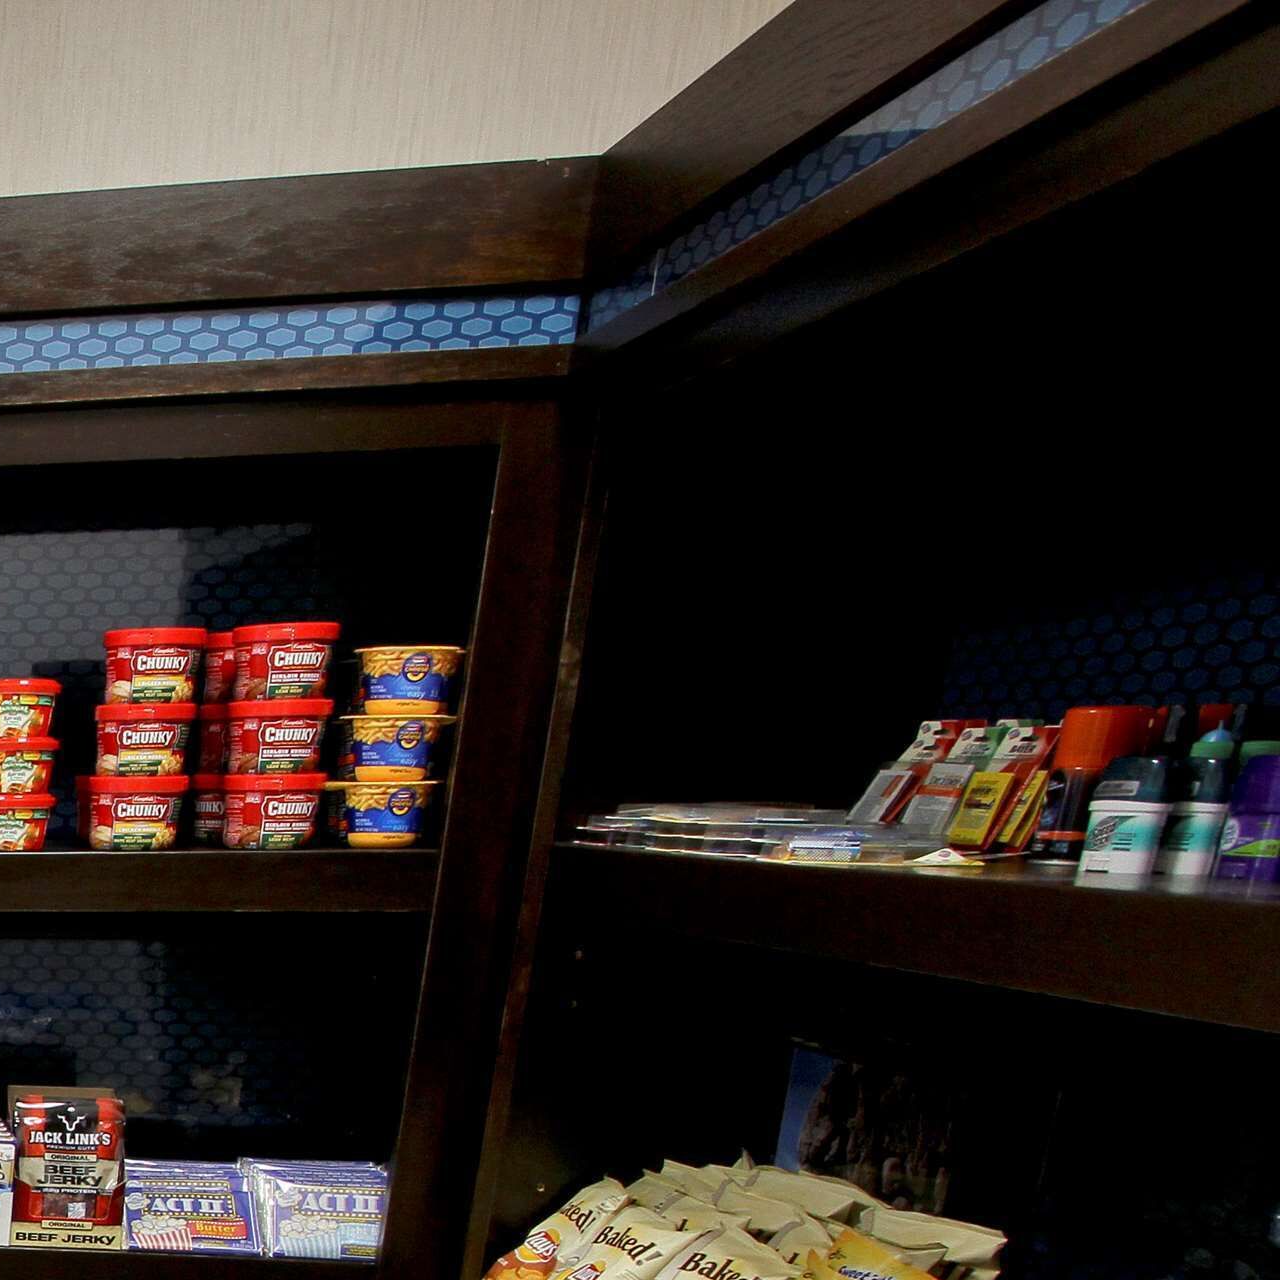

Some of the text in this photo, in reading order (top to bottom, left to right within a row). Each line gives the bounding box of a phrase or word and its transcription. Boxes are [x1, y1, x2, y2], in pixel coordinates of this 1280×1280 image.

[137, 655, 188, 671] CHUNKY
[274, 651, 324, 667] CHUNKY
[123, 730, 174, 746] CHUNKY
[265, 727, 316, 743] CHUNKY
[117, 803, 167, 818] CHUNKY
[268, 800, 316, 816] CHUNKY
[28, 1131, 111, 1146] JACK LINK'S
[50, 1153, 90, 1162] ORIGINAL
[43, 1164, 97, 1175] BEEF
[36, 1174, 104, 1187] JERKY
[151, 1197, 223, 1214] ACT II
[301, 1195, 348, 1212] ACT
[48, 1221, 86, 1230] ORIGINAL
[204, 1221, 237, 1234] Butter
[14, 1231, 116, 1246] BEEF JERKY
[592, 1224, 664, 1267] Baked!
